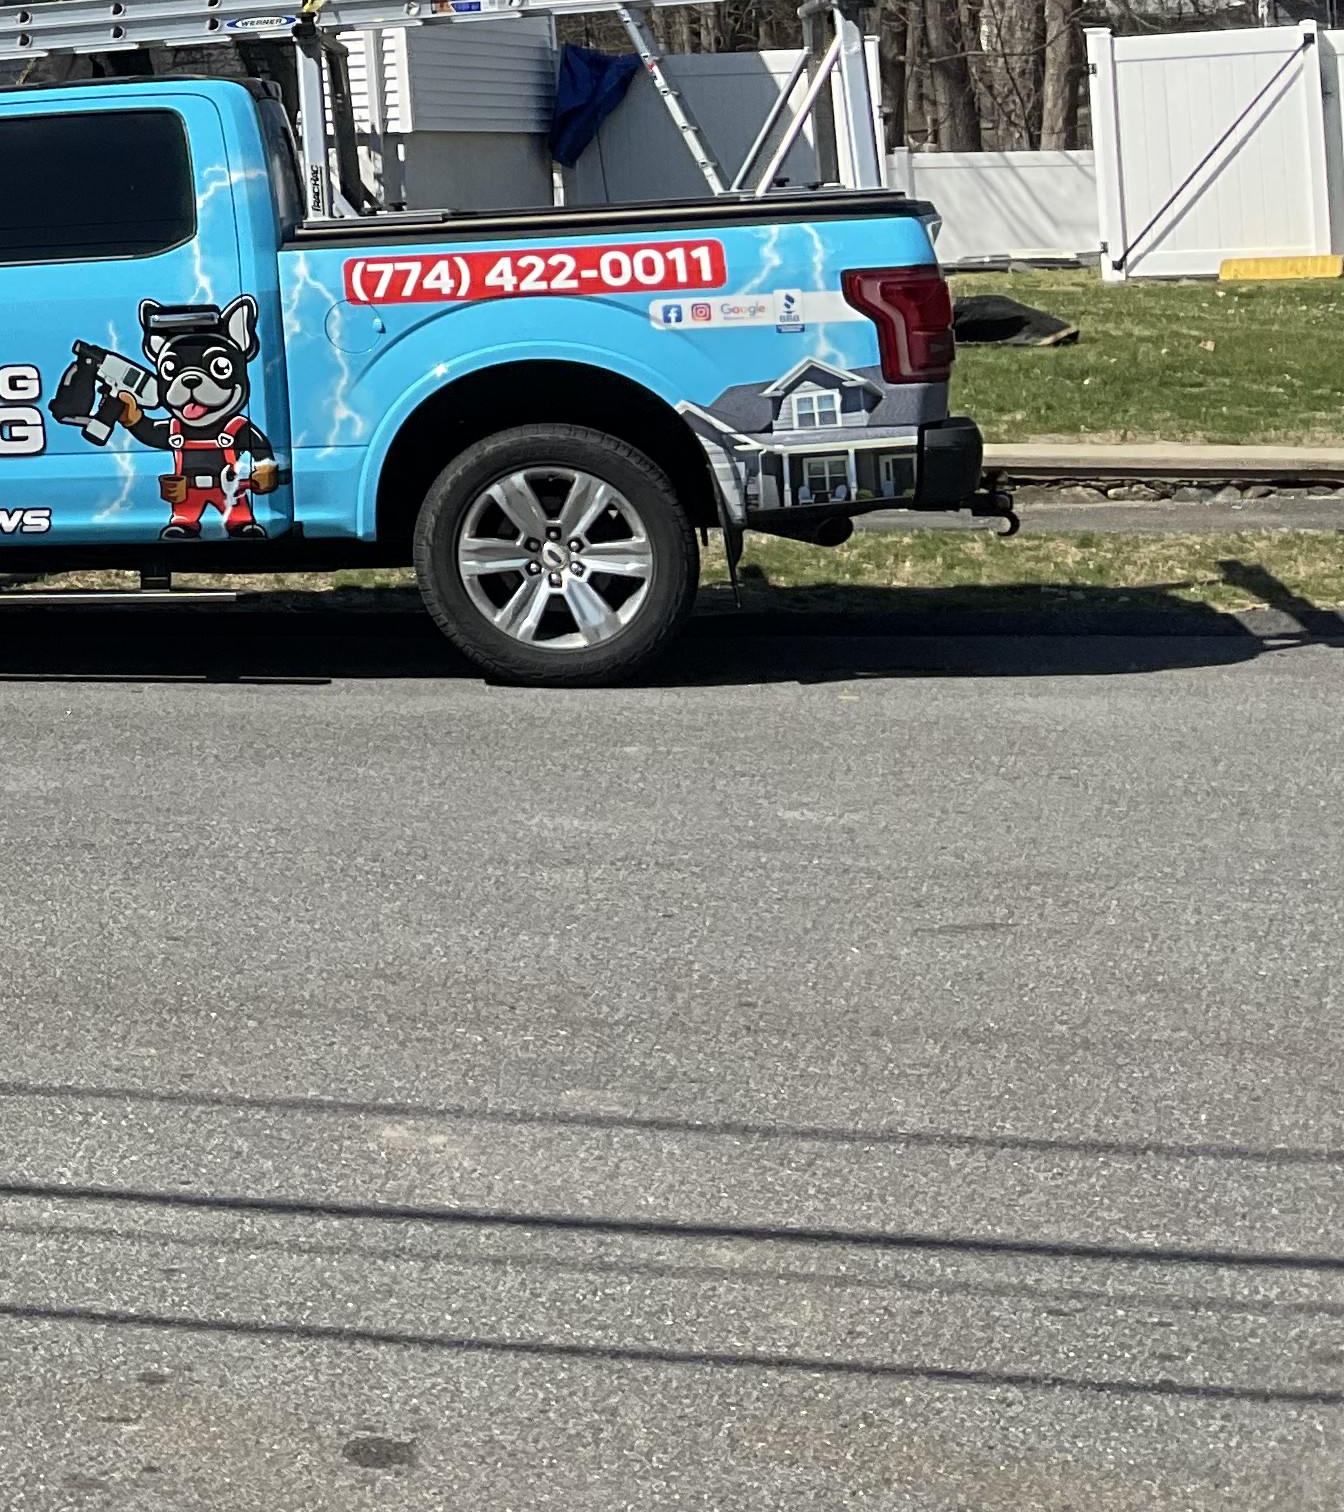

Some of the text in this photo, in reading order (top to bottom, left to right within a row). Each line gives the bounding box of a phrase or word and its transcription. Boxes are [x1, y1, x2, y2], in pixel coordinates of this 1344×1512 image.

[241, 19, 282, 27] WERNER
[351, 245, 714, 302] (774) 422-0011
[720, 302, 766, 317] Google
